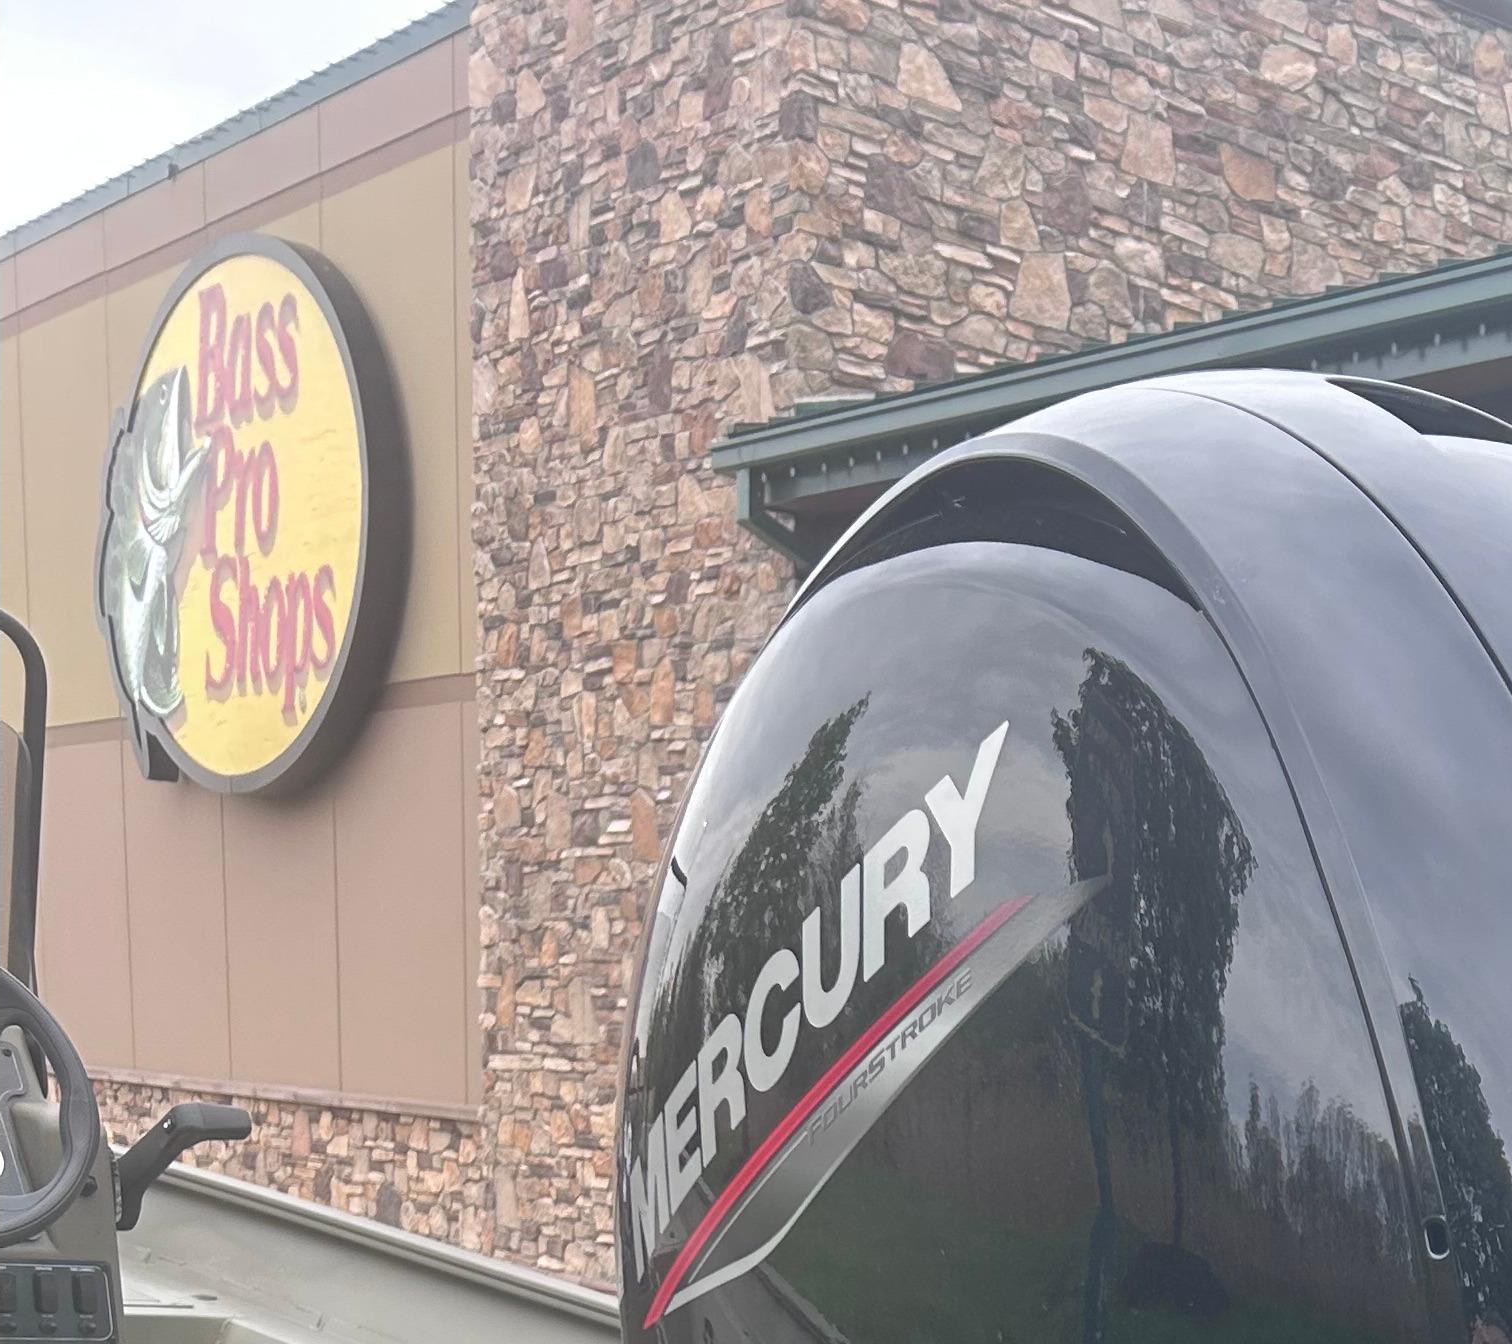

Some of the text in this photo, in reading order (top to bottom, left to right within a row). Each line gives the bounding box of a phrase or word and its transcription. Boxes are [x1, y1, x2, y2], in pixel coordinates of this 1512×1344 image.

[195, 283, 299, 430] Bass
[198, 425, 279, 570] Pro
[205, 554, 337, 726] Shops
[629, 720, 1010, 1285] MERCURY
